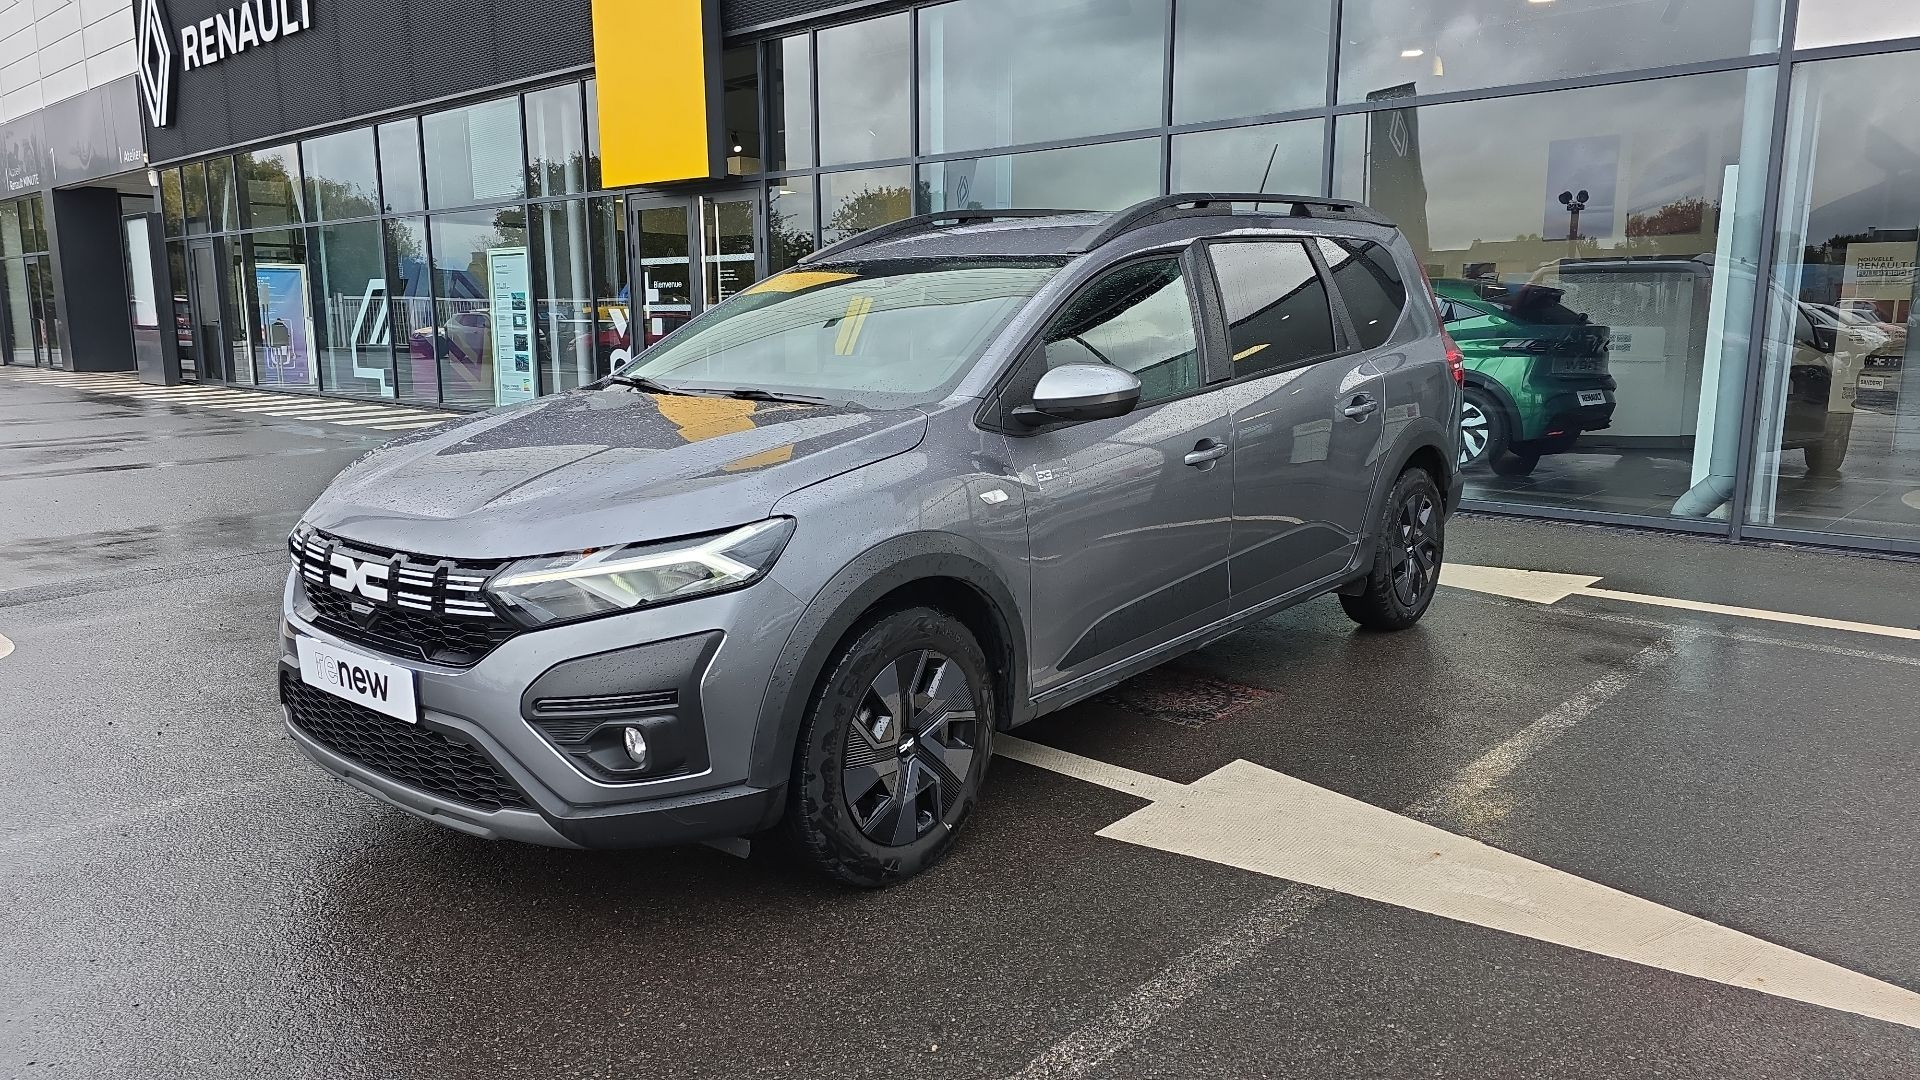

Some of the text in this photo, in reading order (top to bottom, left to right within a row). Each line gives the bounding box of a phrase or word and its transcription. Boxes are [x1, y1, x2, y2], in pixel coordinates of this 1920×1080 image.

[1857, 261, 1908, 270] RENAULT
[653, 280, 683, 289] Bienvenue
[314, 652, 388, 702] renew
